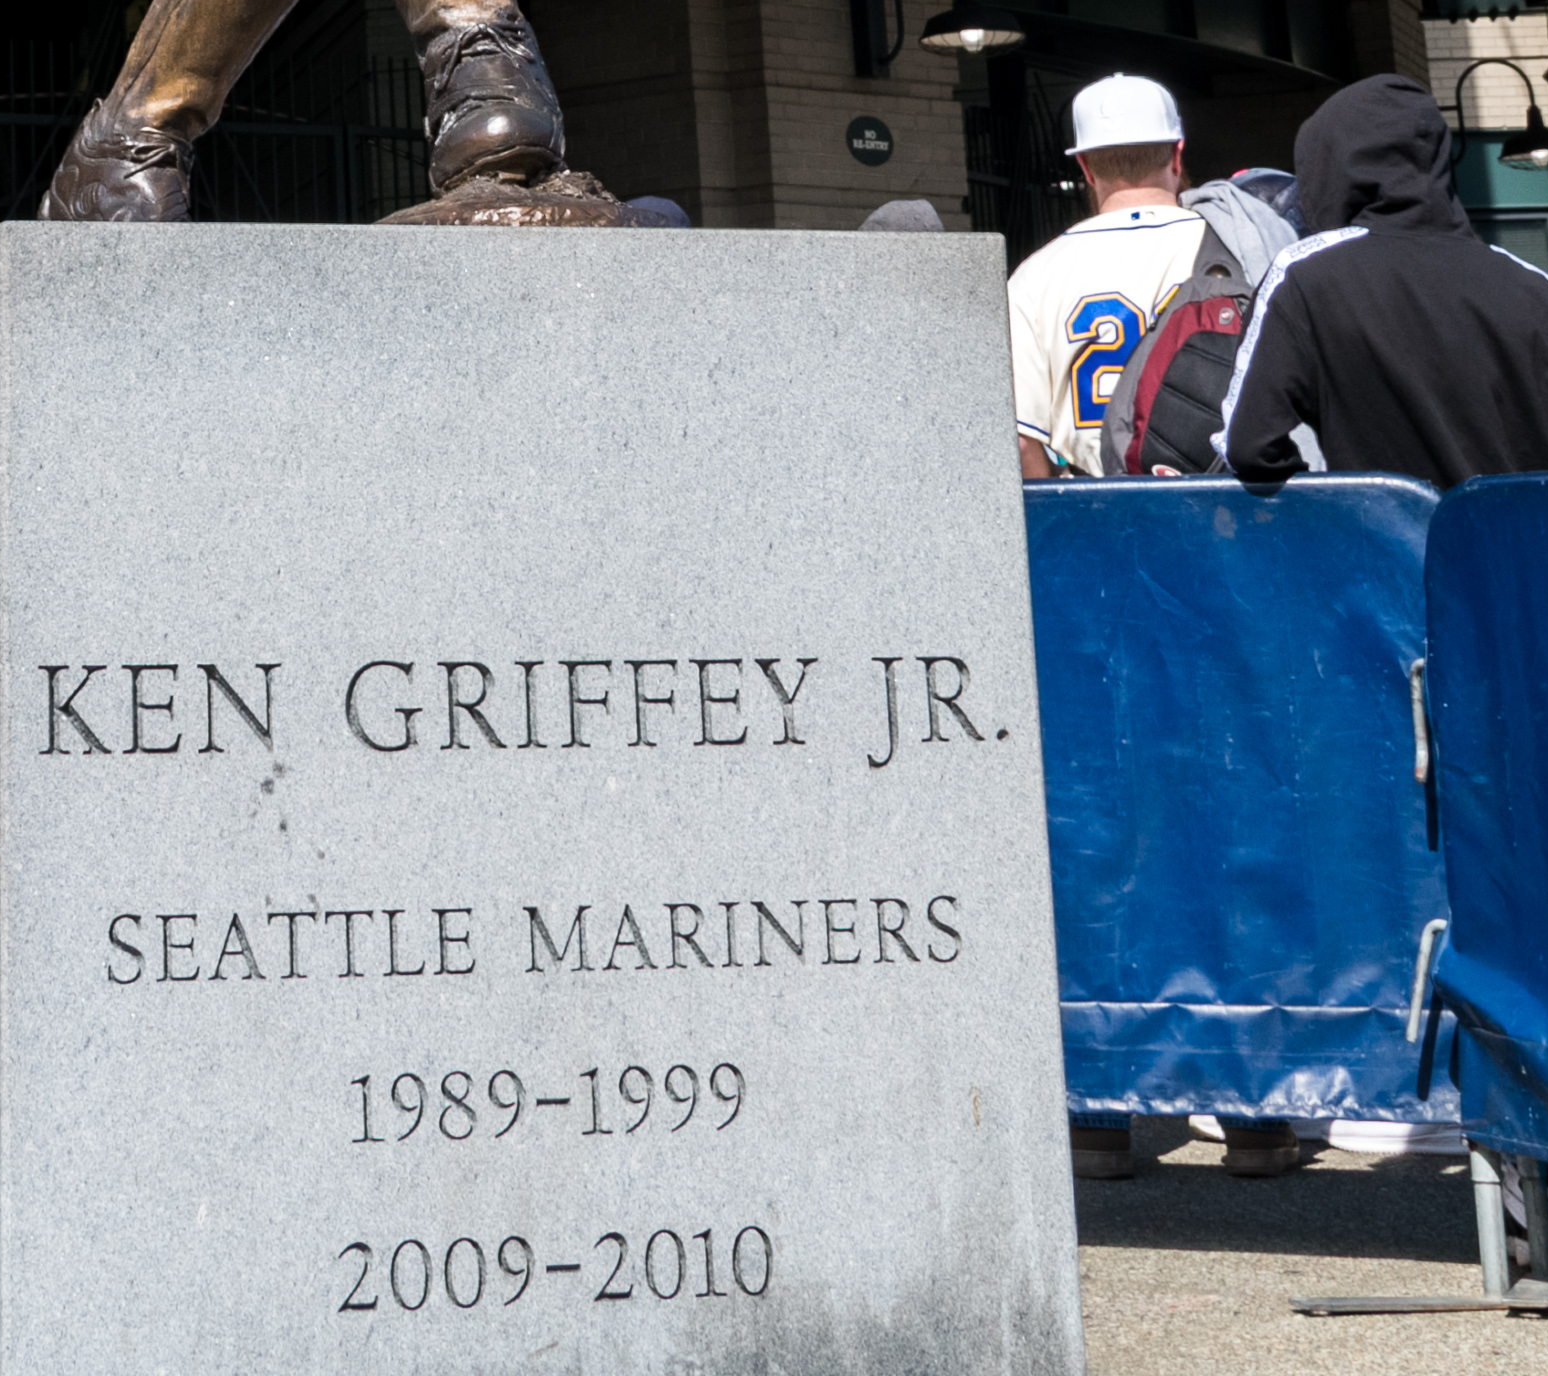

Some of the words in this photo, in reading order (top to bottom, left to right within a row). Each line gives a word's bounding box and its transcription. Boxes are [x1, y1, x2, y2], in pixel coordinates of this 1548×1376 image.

[1065, 283, 1182, 430] 2
[37, 660, 285, 758] KEN
[343, 655, 818, 754] GRIFFEY
[866, 654, 1012, 770] JR.
[105, 905, 478, 986] SEATTLE
[523, 895, 965, 976] MARINERS
[349, 1061, 747, 1145] 1989-1999
[337, 1225, 776, 1313] 2009-2010
